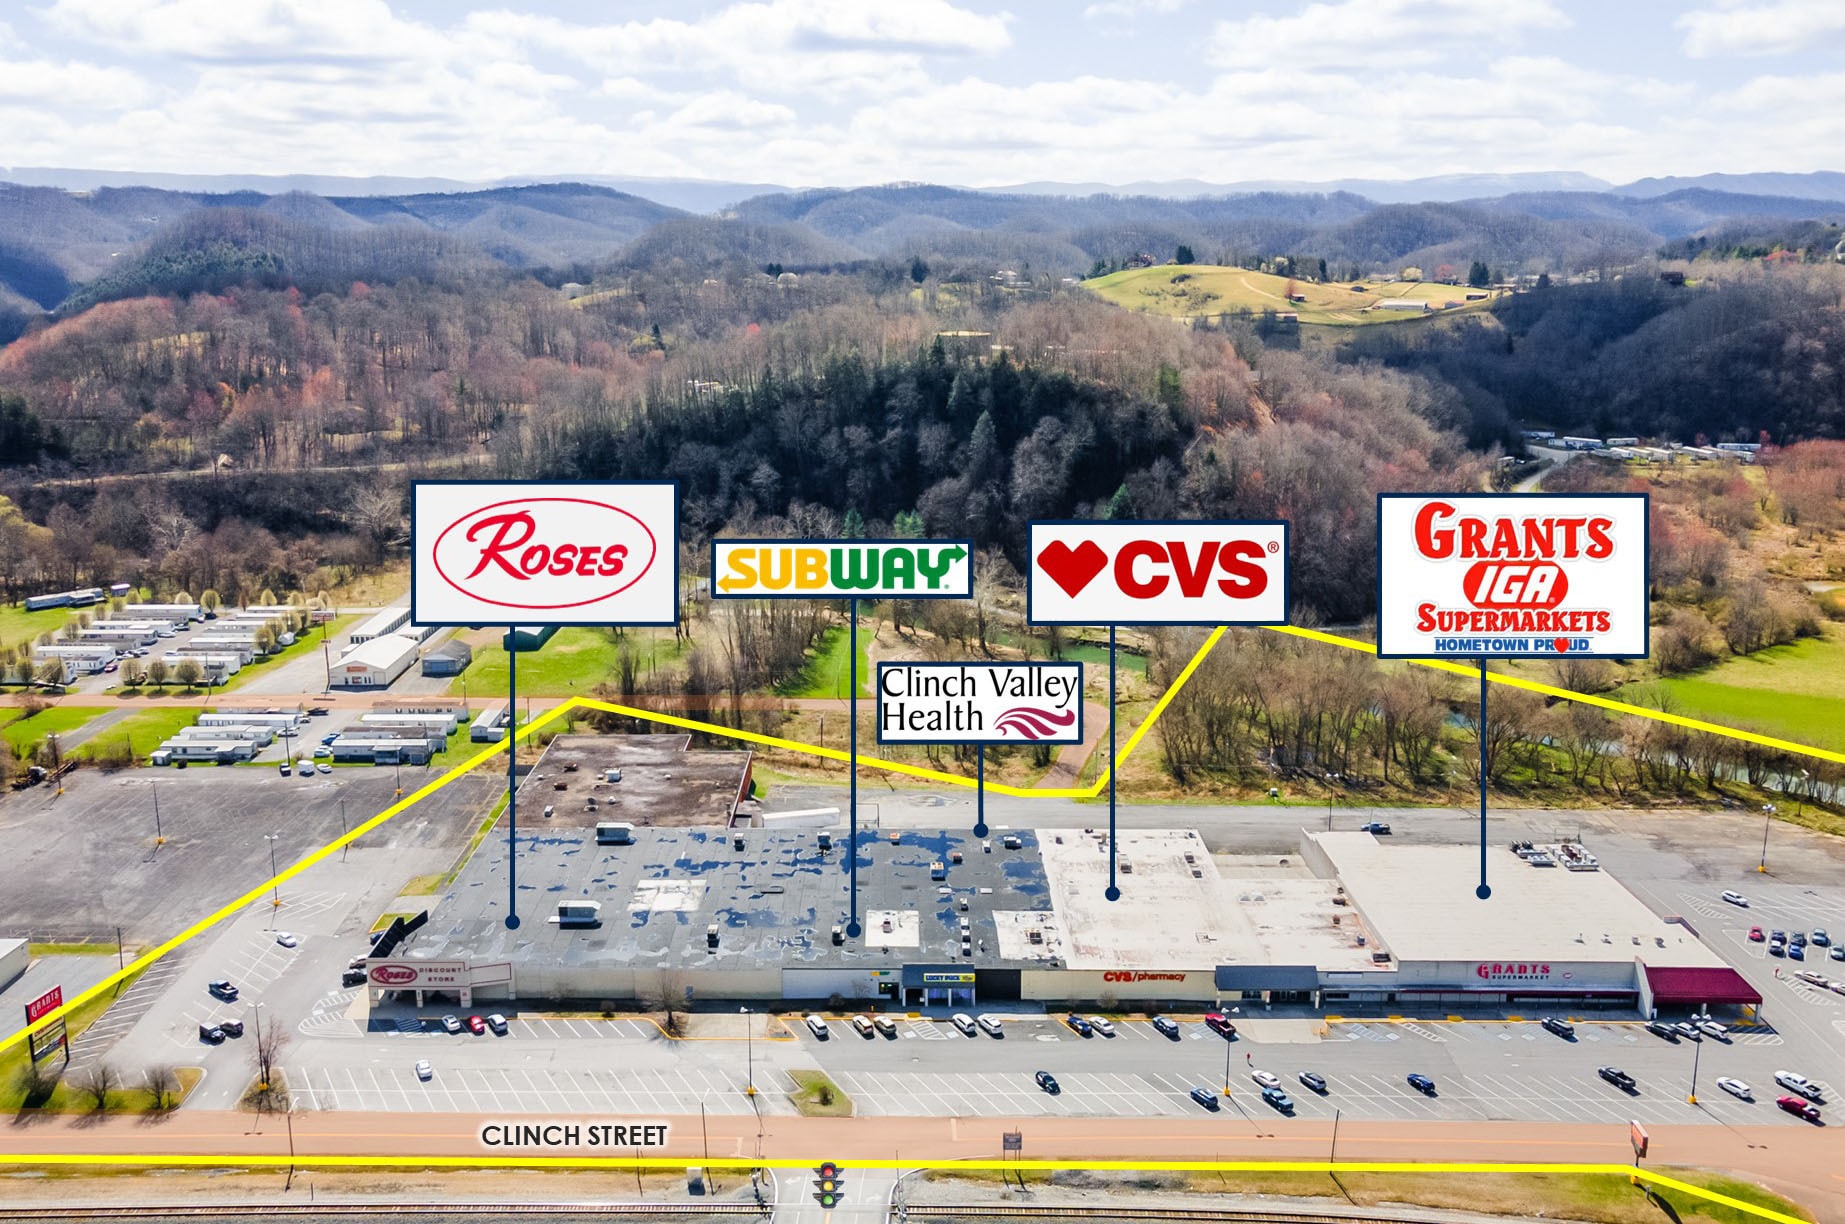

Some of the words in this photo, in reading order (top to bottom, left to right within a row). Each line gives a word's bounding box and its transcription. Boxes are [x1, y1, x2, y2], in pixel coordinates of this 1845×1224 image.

[1103, 971, 1186, 982] CVS/pharmacy
[1477, 964, 1550, 979] GRANTS
[31, 991, 60, 1017] GRANTS
